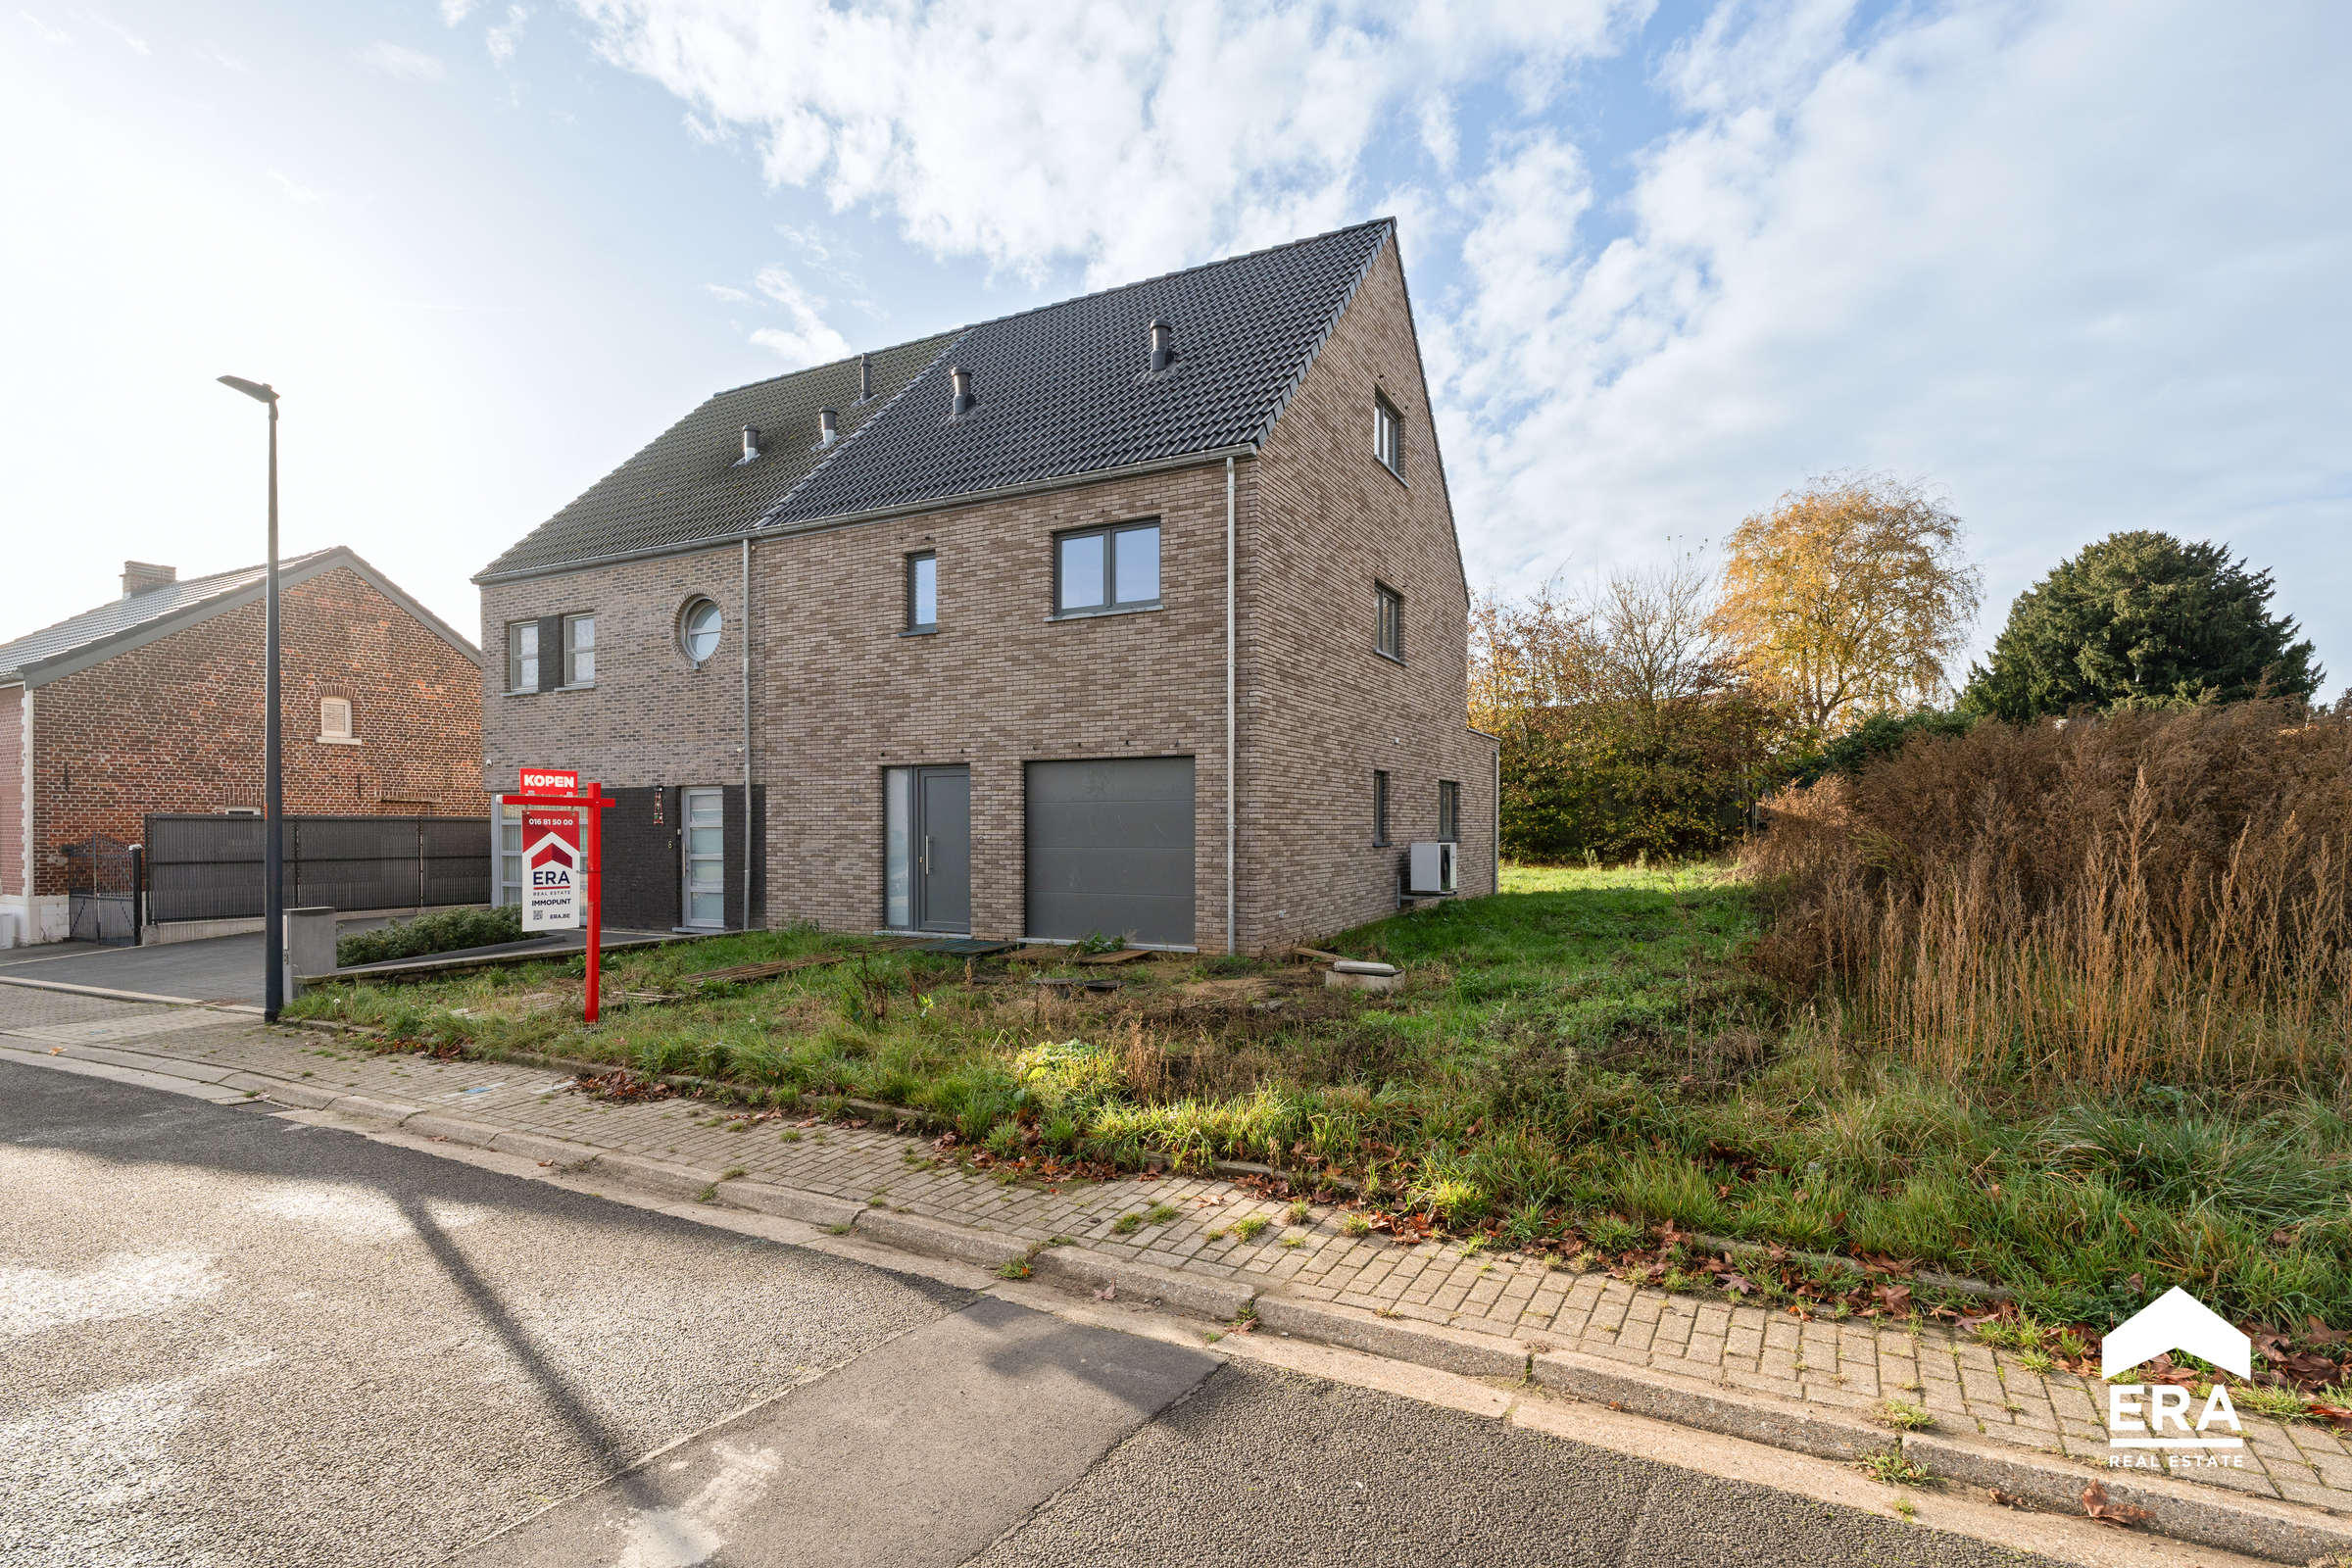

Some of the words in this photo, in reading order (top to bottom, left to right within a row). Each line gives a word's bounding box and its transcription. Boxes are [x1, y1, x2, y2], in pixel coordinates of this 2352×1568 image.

[523, 774, 575, 788] KOPEN
[532, 870, 570, 885] ERA
[531, 898, 571, 906] IMMOPUNT
